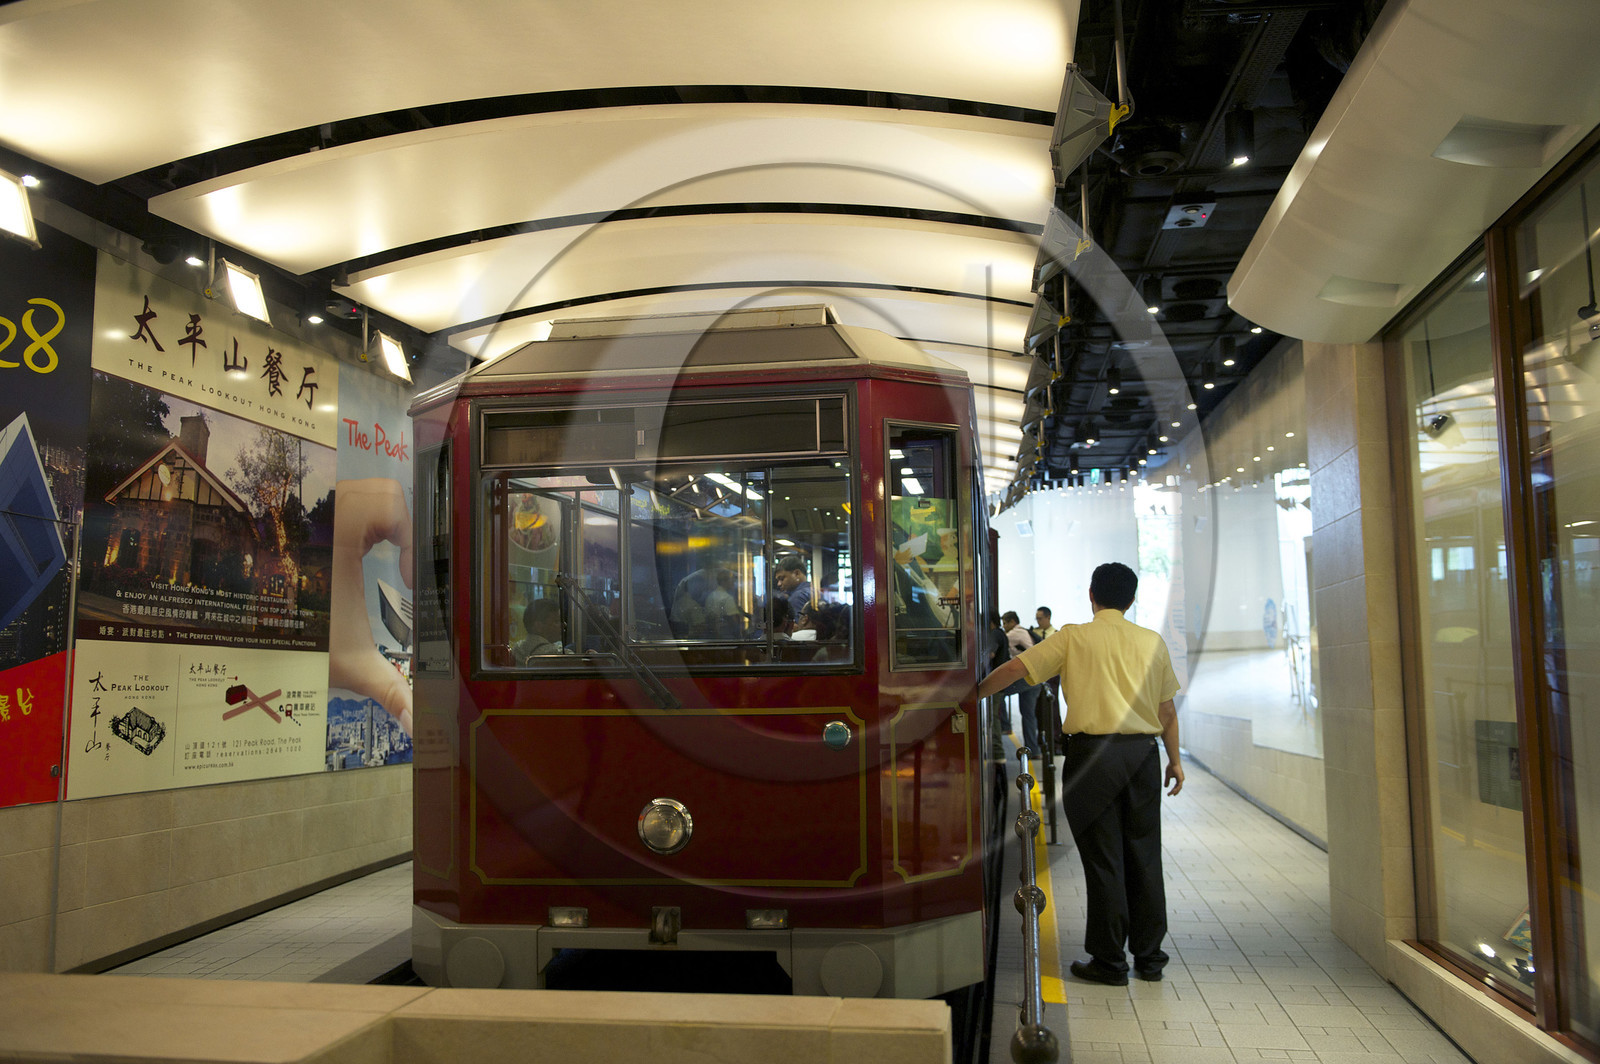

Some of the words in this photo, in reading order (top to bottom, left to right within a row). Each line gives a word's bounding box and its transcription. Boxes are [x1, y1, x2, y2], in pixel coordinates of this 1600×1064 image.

[130, 295, 319, 410] 太平山餐厅
[128, 358, 153, 373] THE
[162, 370, 194, 387] PEAK
[201, 383, 253, 408] LOOKOUT
[259, 404, 287, 420] HONG
[291, 415, 317, 430] KONG
[342, 417, 372, 449] The
[374, 422, 410, 463] Peak
[124, 591, 147, 600] ENJOY
[160, 595, 193, 605] ALFRESCO
[194, 598, 241, 610] INTERNATIONAL
[242, 604, 259, 612] FEAST
[150, 581, 169, 591] VISIT
[170, 583, 190, 593] HONG
[191, 586, 215, 596] KONG'S
[233, 592, 260, 601] HISTORIC
[260, 595, 294, 604] RESTAURANT
[176, 631, 189, 639] THE
[189, 632, 214, 640] PERFECT
[214, 634, 233, 643] VENUE
[272, 638, 291, 646] SPECIAL
[292, 639, 317, 647] FUNCTIONS
[278, 738, 287, 746] The
[288, 736, 302, 744] Peak
